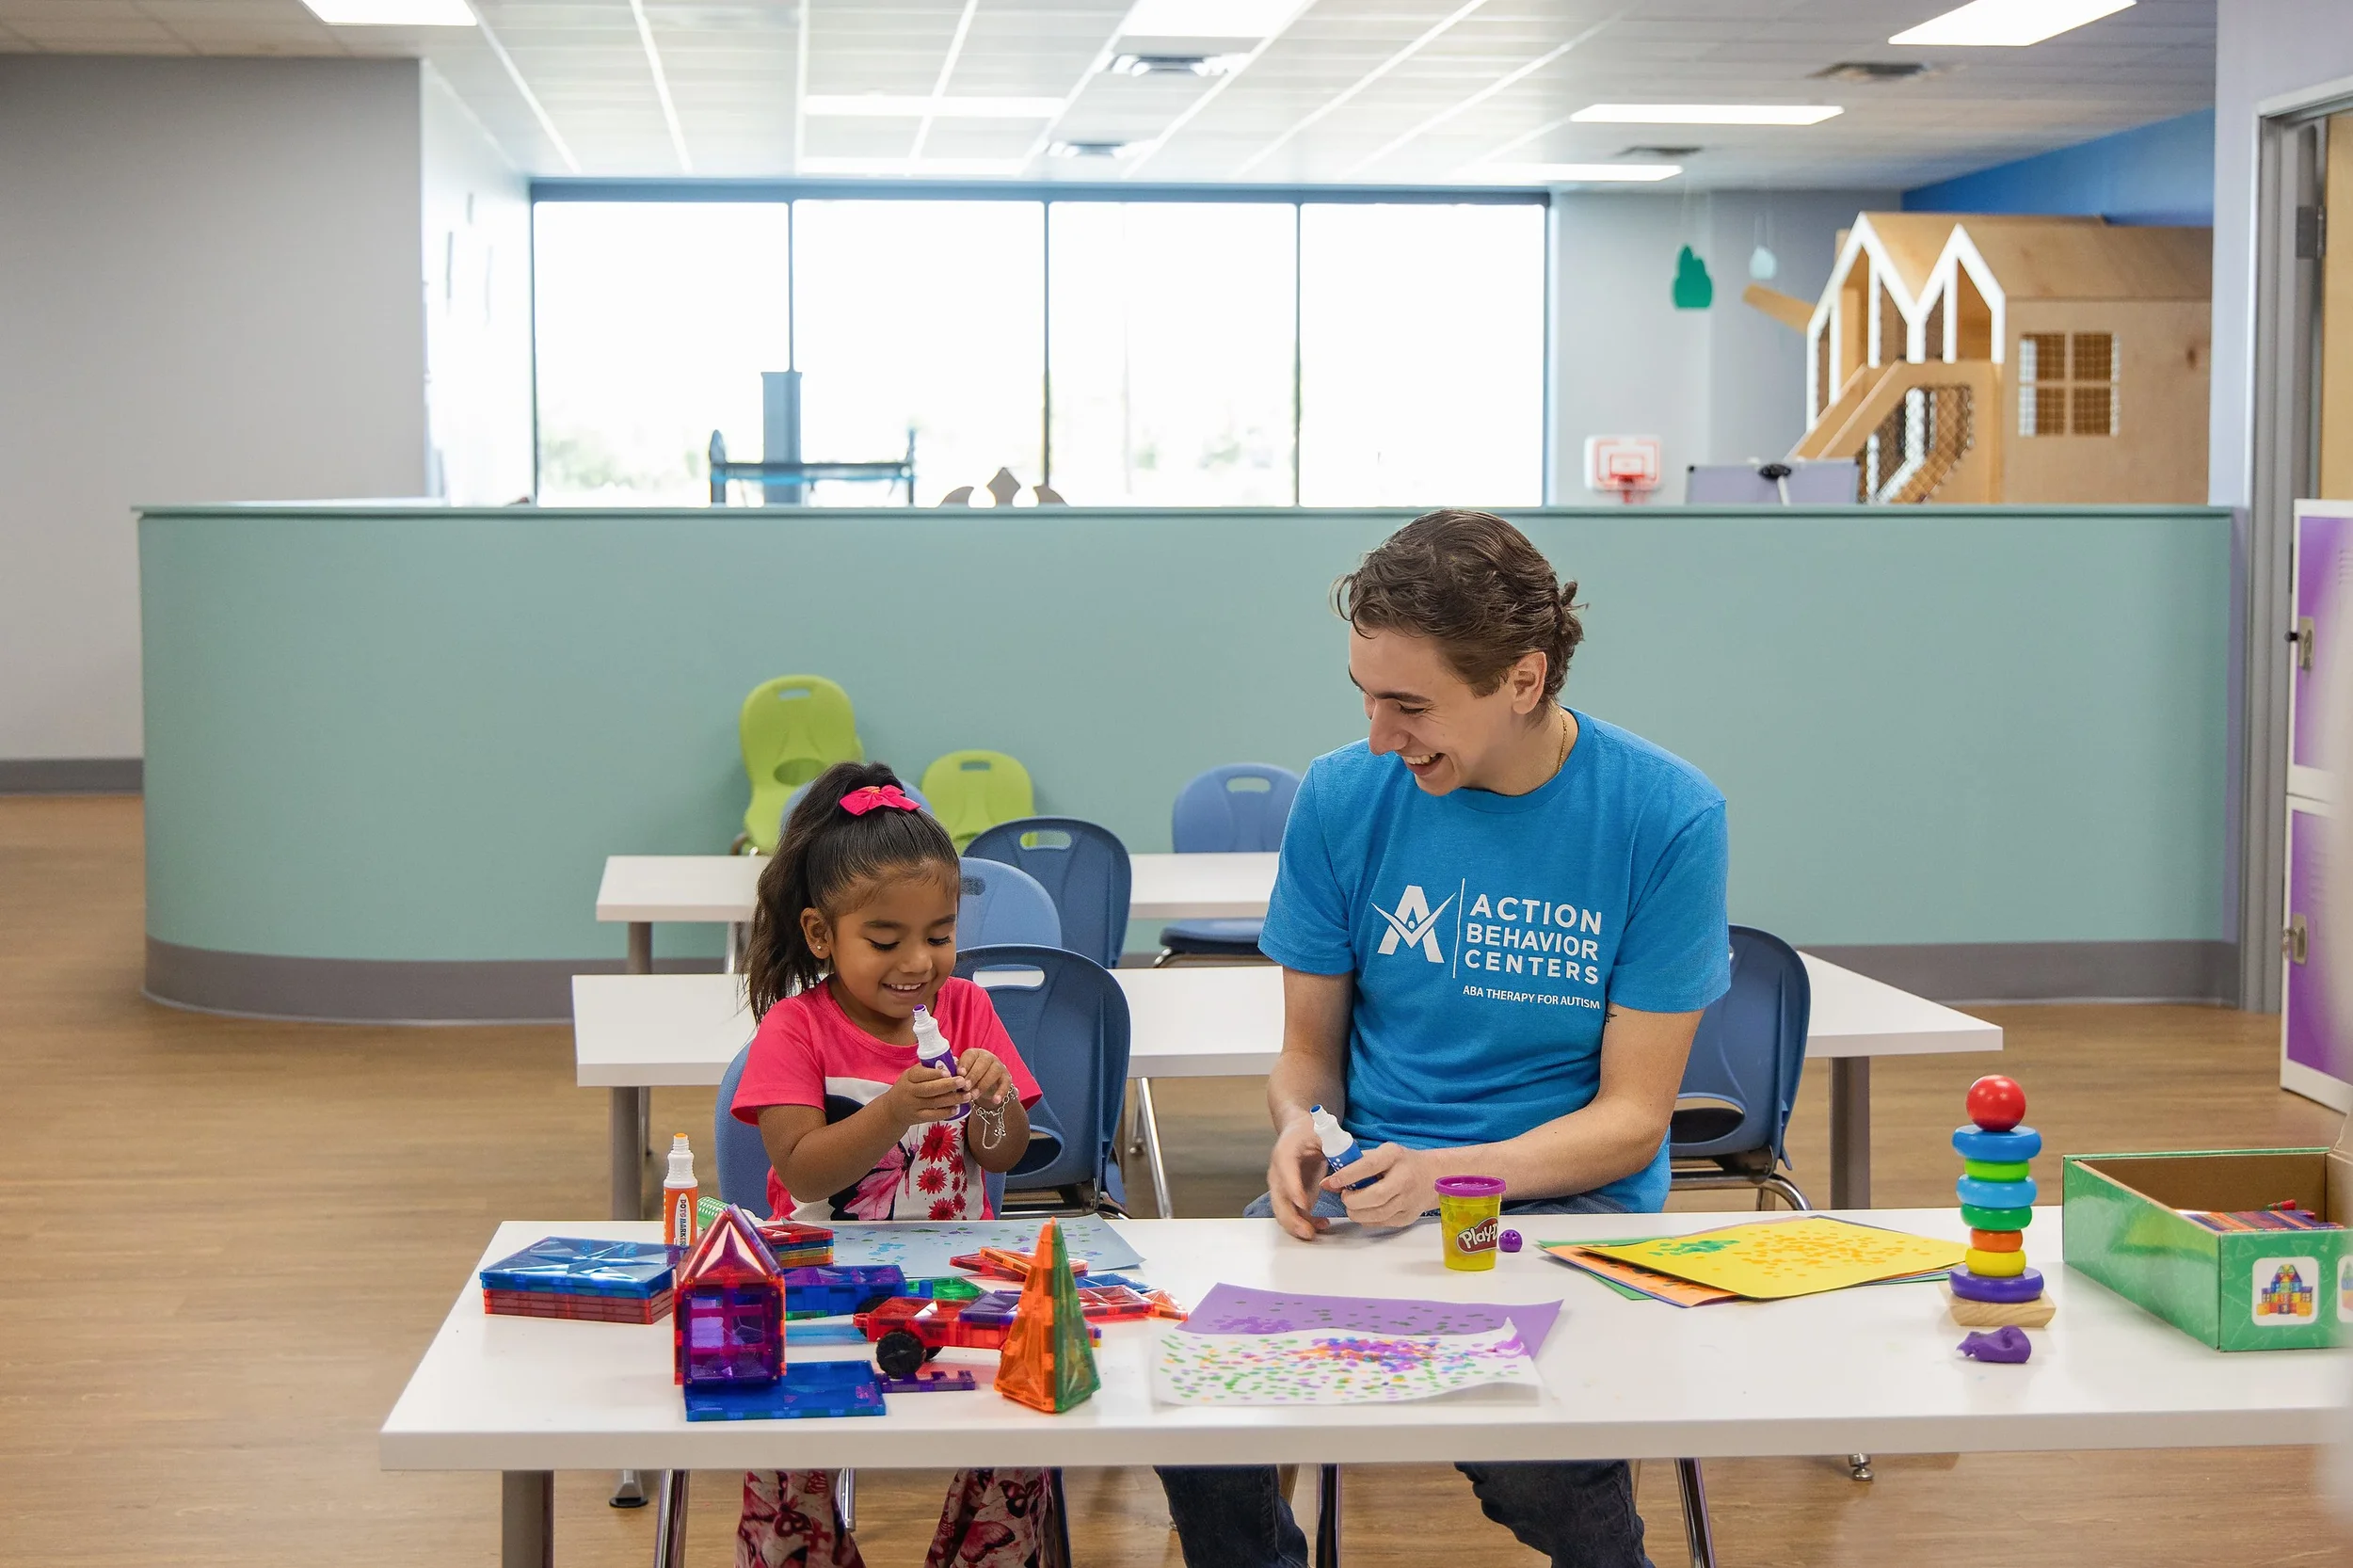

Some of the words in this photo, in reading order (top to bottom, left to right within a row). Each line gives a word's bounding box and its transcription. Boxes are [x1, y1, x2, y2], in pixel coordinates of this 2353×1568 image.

[1469, 893, 1602, 936] ACTION
[1465, 922, 1598, 962] BEHAVIOR
[1465, 949, 1599, 985] CENTERS
[1463, 984, 1484, 998] ABA
[1485, 988, 1535, 1004] THERAPY
[1537, 994, 1559, 1005] FOR
[1560, 995, 1601, 1010] AUTISM
